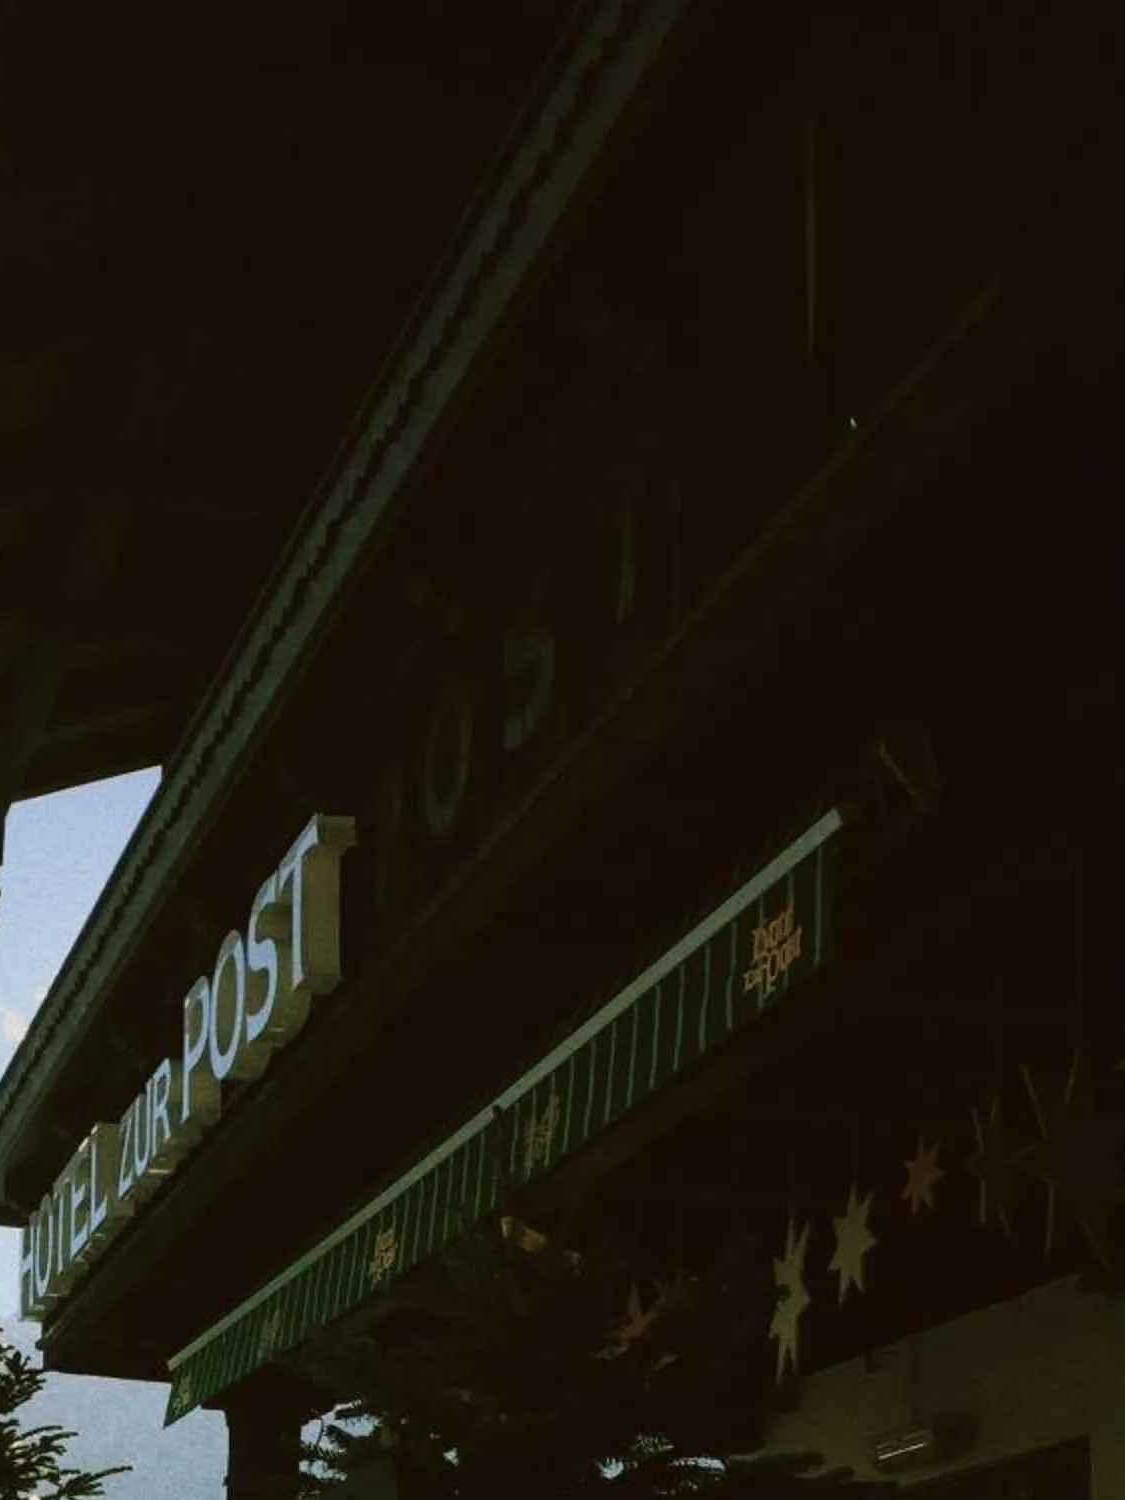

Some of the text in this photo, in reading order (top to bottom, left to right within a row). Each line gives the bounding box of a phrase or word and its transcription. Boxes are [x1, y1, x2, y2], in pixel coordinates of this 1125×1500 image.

[18, 813, 321, 1321] HOTEL ZUR POST
